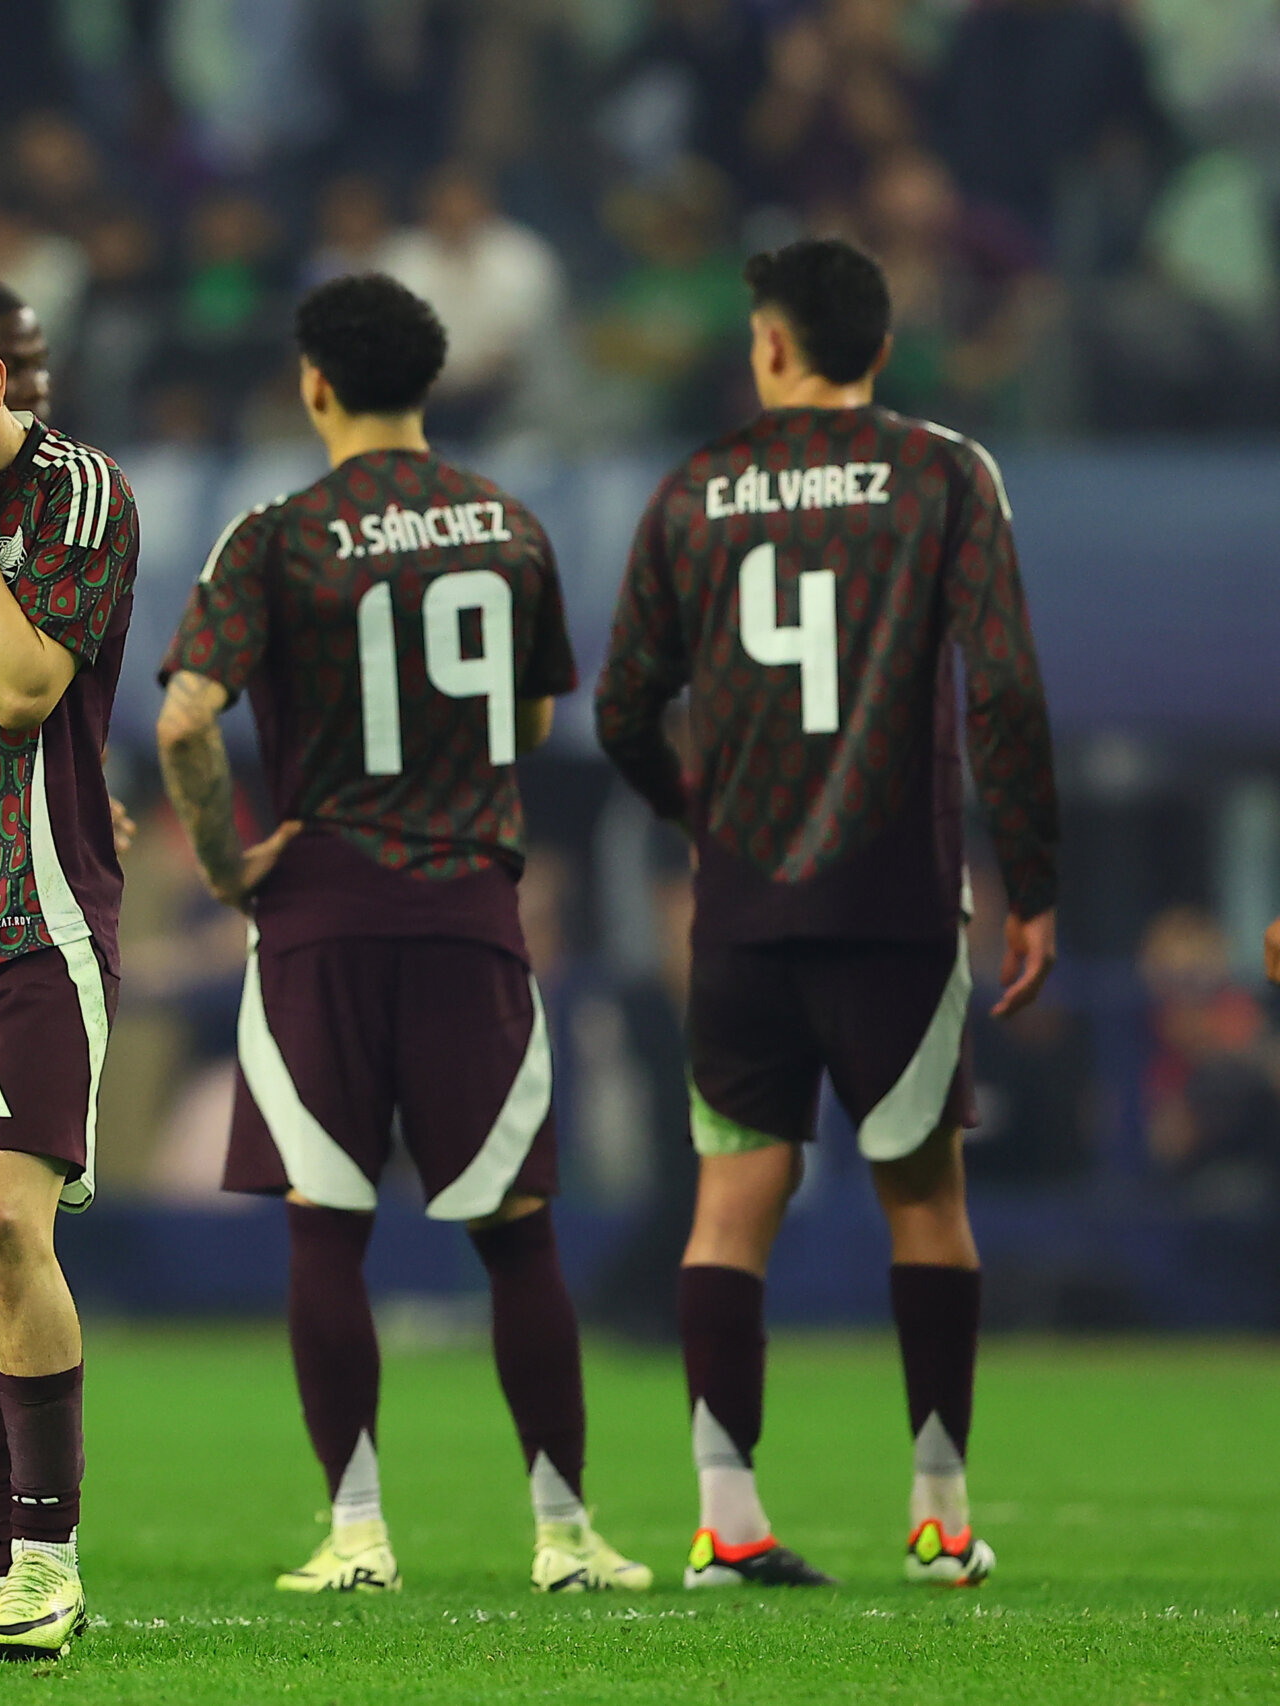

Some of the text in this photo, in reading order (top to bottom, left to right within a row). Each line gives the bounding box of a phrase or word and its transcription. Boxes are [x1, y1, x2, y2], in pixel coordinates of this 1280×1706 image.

[328, 501, 512, 560] J.SÁNCHEZ
[705, 462, 891, 520] E.ÁLVAREZ
[357, 569, 516, 776] 19
[738, 542, 839, 733] 4
